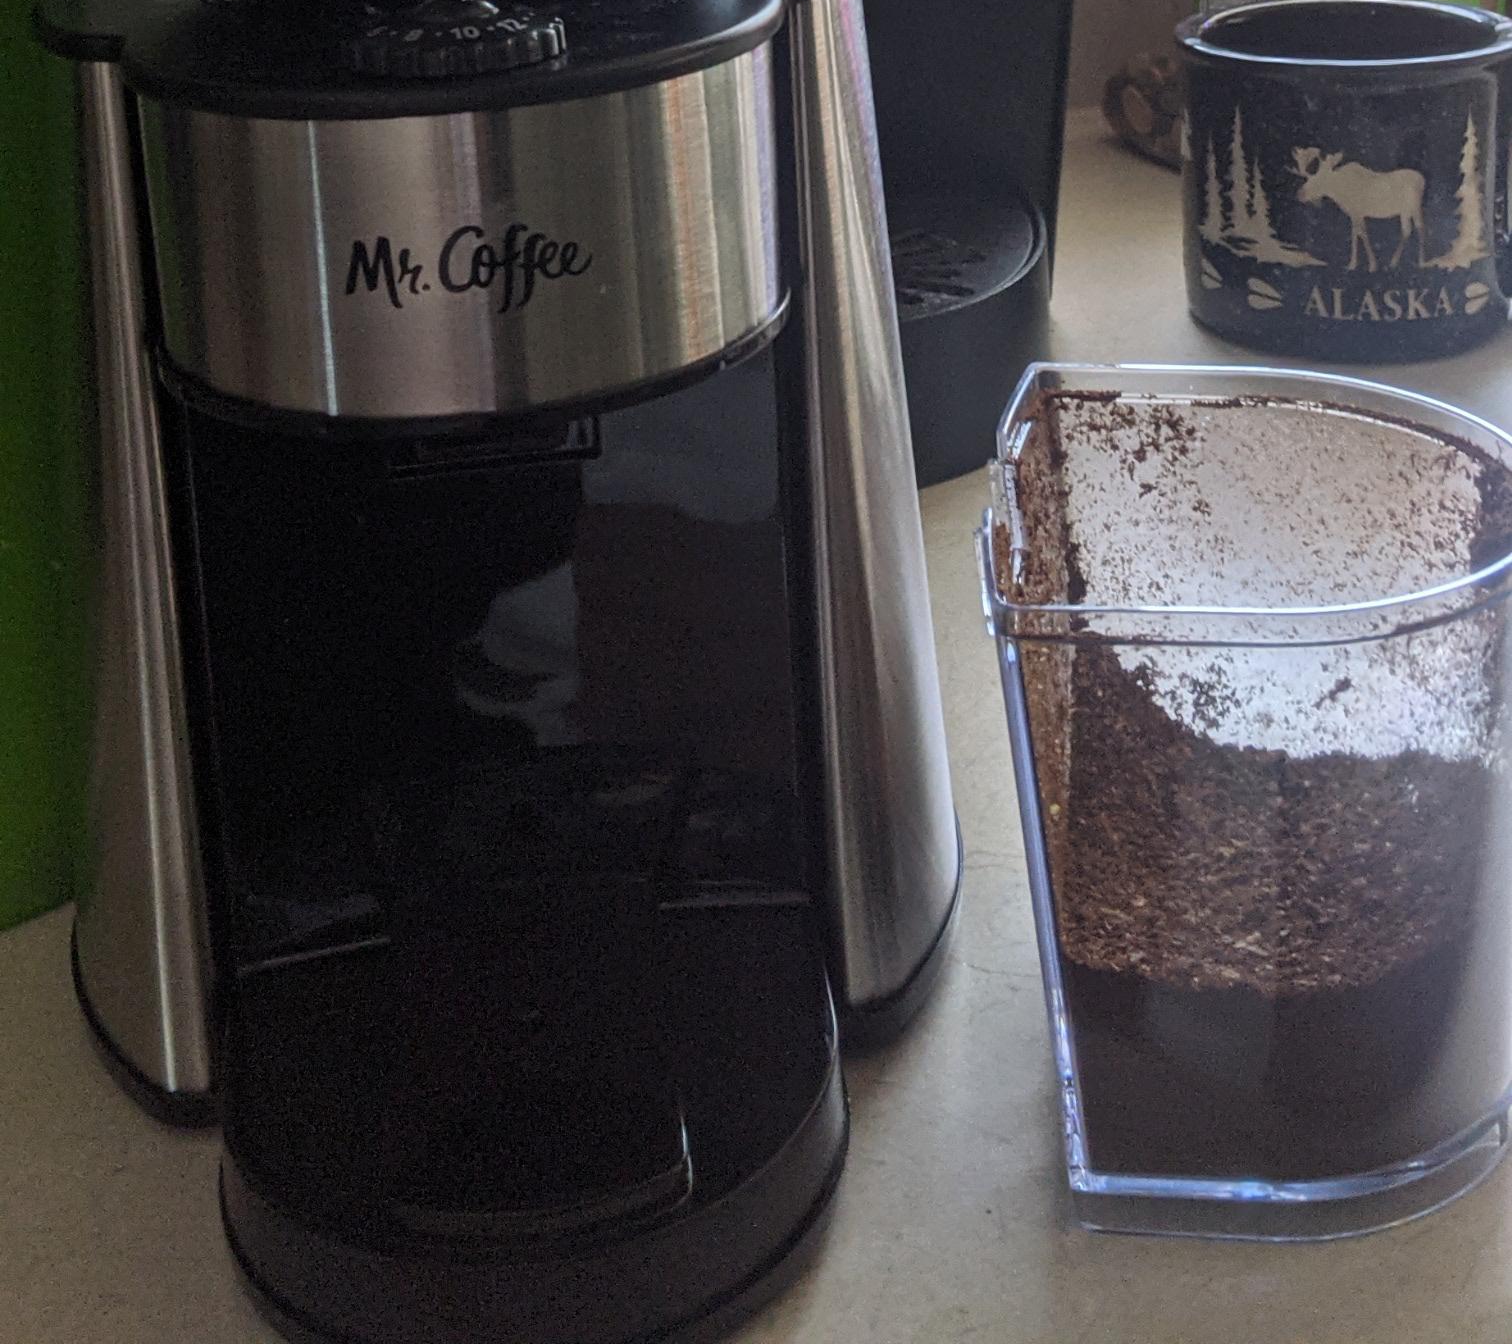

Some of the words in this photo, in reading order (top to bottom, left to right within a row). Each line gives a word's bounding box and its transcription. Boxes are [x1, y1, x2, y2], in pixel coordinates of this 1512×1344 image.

[450, 25, 481, 40] 10
[345, 235, 431, 309] Mr.
[438, 223, 593, 314] Coffee
[1303, 285, 1454, 322] ALASKA
